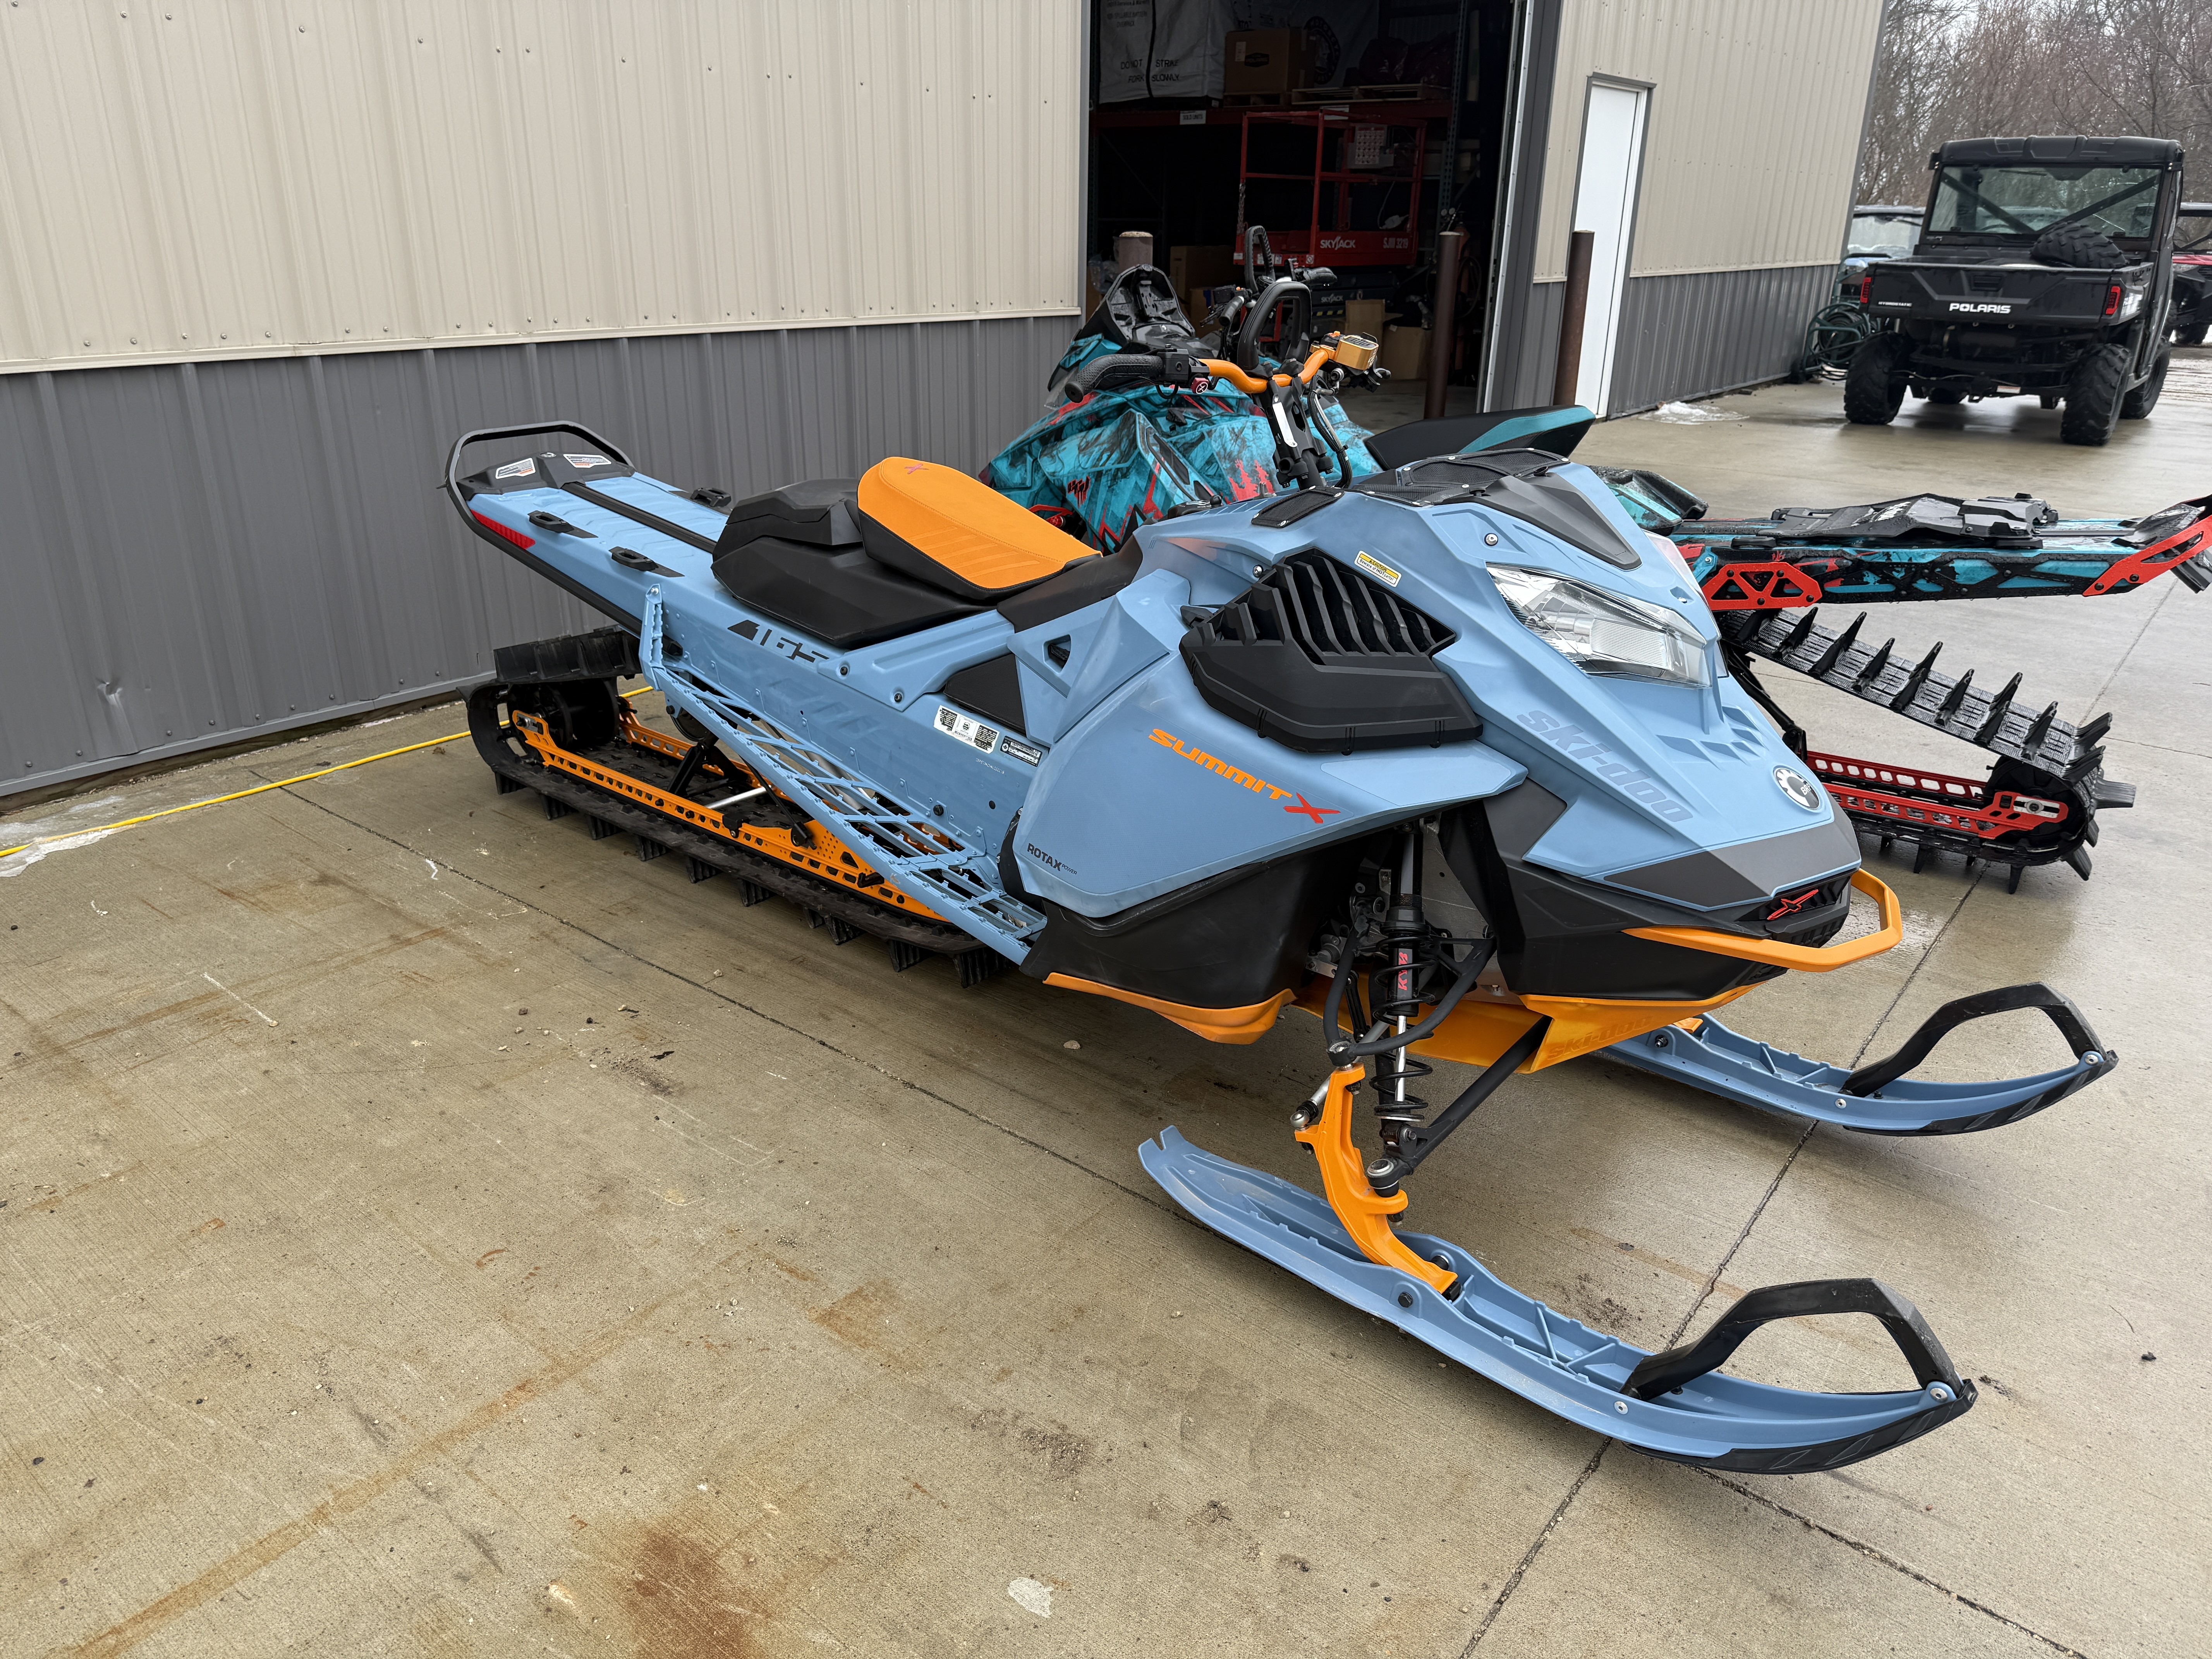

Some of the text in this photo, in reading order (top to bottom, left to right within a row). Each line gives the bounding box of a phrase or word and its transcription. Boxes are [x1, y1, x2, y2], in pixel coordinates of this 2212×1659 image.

[1121, 59, 1179, 69] DO NOT STRIKE
[1128, 74, 1145, 83] FORK
[1320, 235, 1356, 250] SKYJACK
[1321, 293, 1344, 303] SKYJACK
[1949, 302, 2012, 314] POLARIS
[1360, 559, 1372, 568] Beware
[1372, 560, 1387, 572] CAUTION
[1517, 710, 1693, 823] ski-doo
[1148, 728, 1341, 824] SUMMIT X
[1800, 783, 1812, 795] BRP
[1027, 843, 1077, 875] ROTAX POWER
